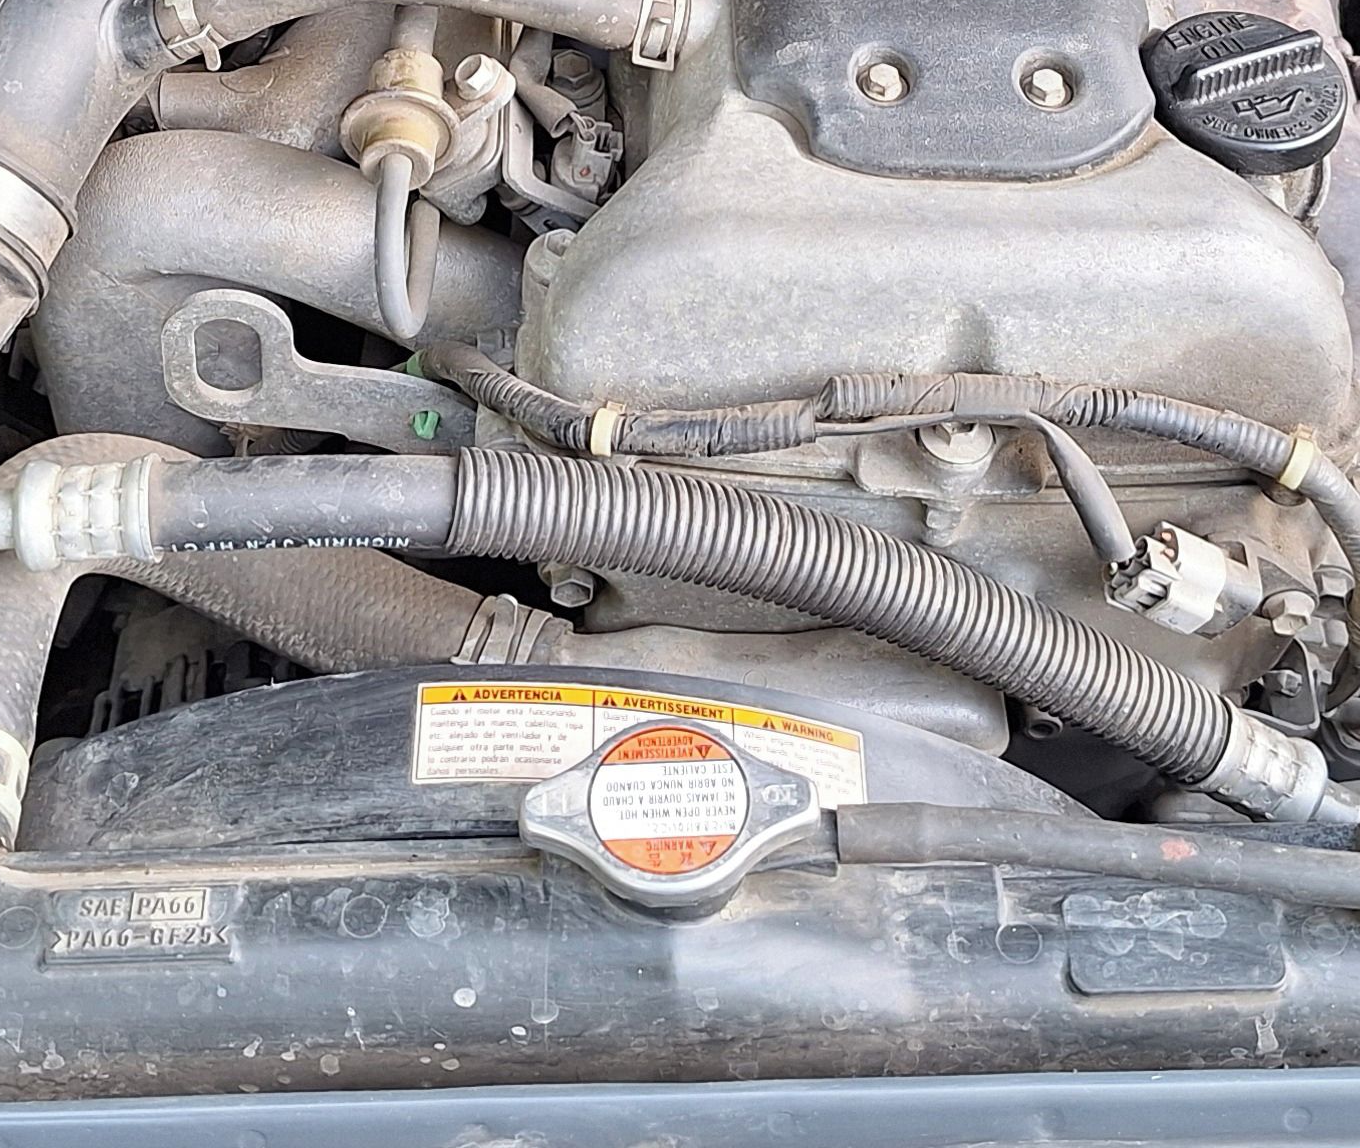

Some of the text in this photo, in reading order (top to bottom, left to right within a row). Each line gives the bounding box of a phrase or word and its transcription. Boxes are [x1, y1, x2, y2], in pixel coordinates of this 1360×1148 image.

[1165, 14, 1256, 51] ENGINE
[1200, 37, 1245, 60] OIL
[473, 689, 562, 701] ADVERTENCIA
[623, 697, 724, 719] AVERTISSEMENT
[781, 721, 834, 742] WARNING
[637, 736, 693, 747] ADVERTENCIA
[618, 748, 693, 760] AVERTISSEMENT
[712, 763, 734, 774] ESTE
[606, 778, 734, 792] NO ABRIR NUNCA CUANDO
[648, 793, 682, 805] OUVRIR
[687, 792, 720, 803] JAMAIS
[724, 791, 735, 801] NE
[642, 808, 670, 819] WHEN
[675, 807, 700, 818] OPEN
[705, 806, 736, 817] NEVER
[645, 839, 694, 851] WARNING
[79, 895, 196, 917] SAE PA66
